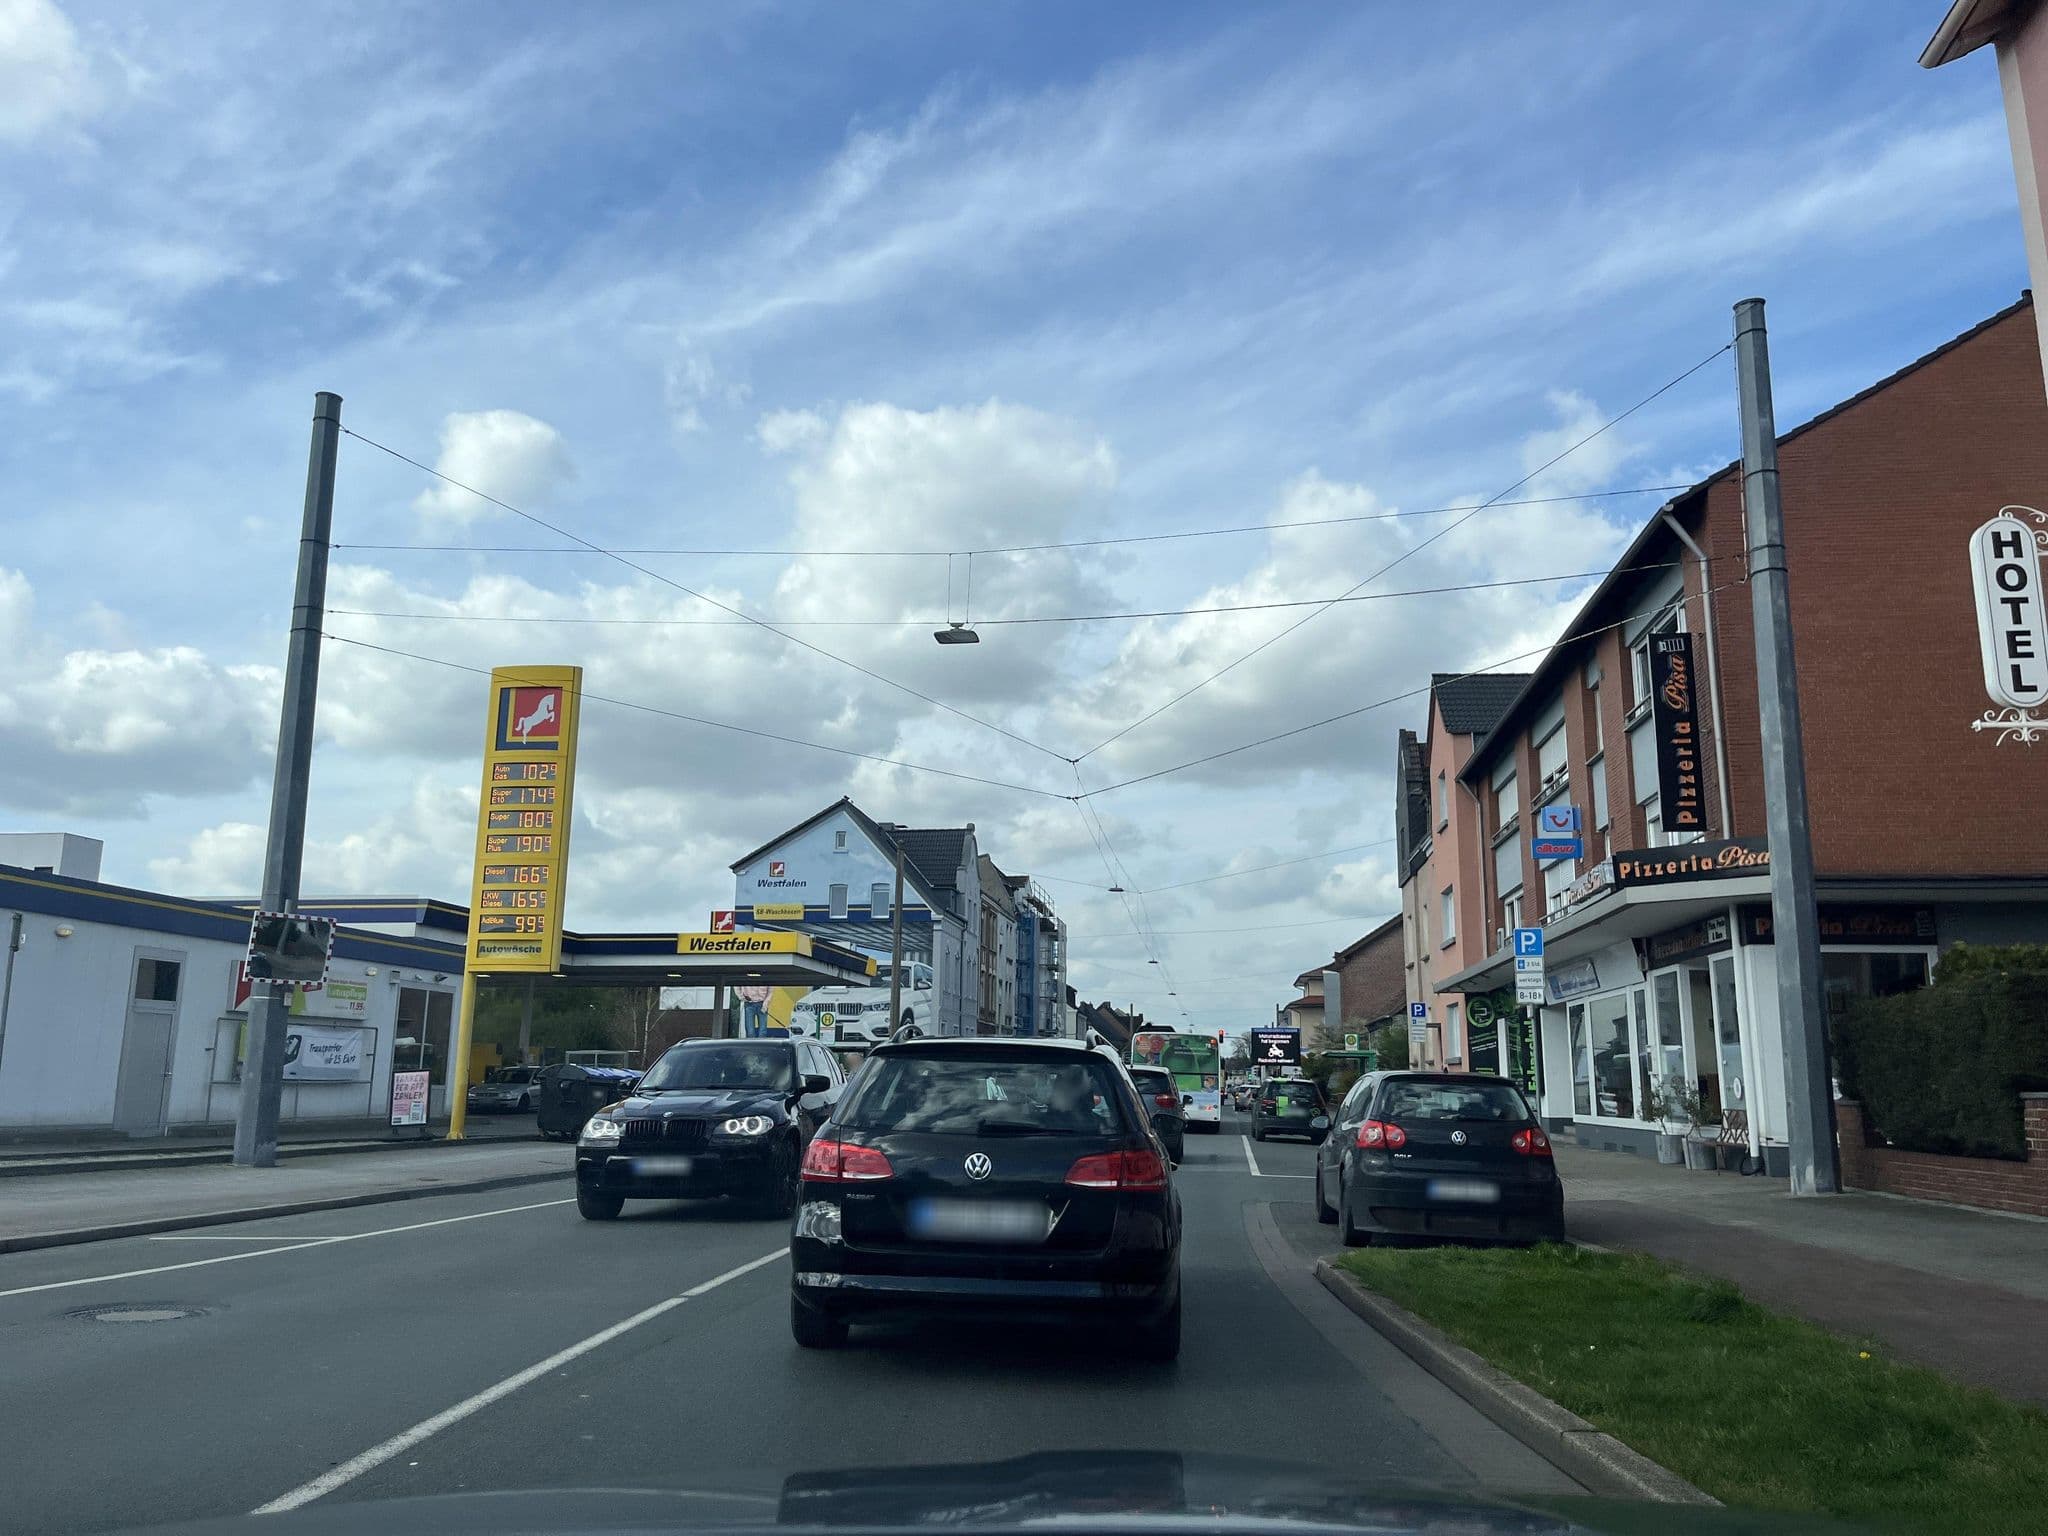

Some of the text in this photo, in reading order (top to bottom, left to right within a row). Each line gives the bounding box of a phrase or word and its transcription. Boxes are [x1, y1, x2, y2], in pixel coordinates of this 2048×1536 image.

[1991, 530, 2038, 692] HOTEL
[1662, 654, 1698, 825] Pizzeria Pisa
[490, 813, 510, 821] Super
[1619, 846, 1770, 879] Pizzeria Pisa
[758, 880, 807, 888] Westfalen
[690, 937, 772, 951] Westfalen
[1520, 932, 1536, 954] P
